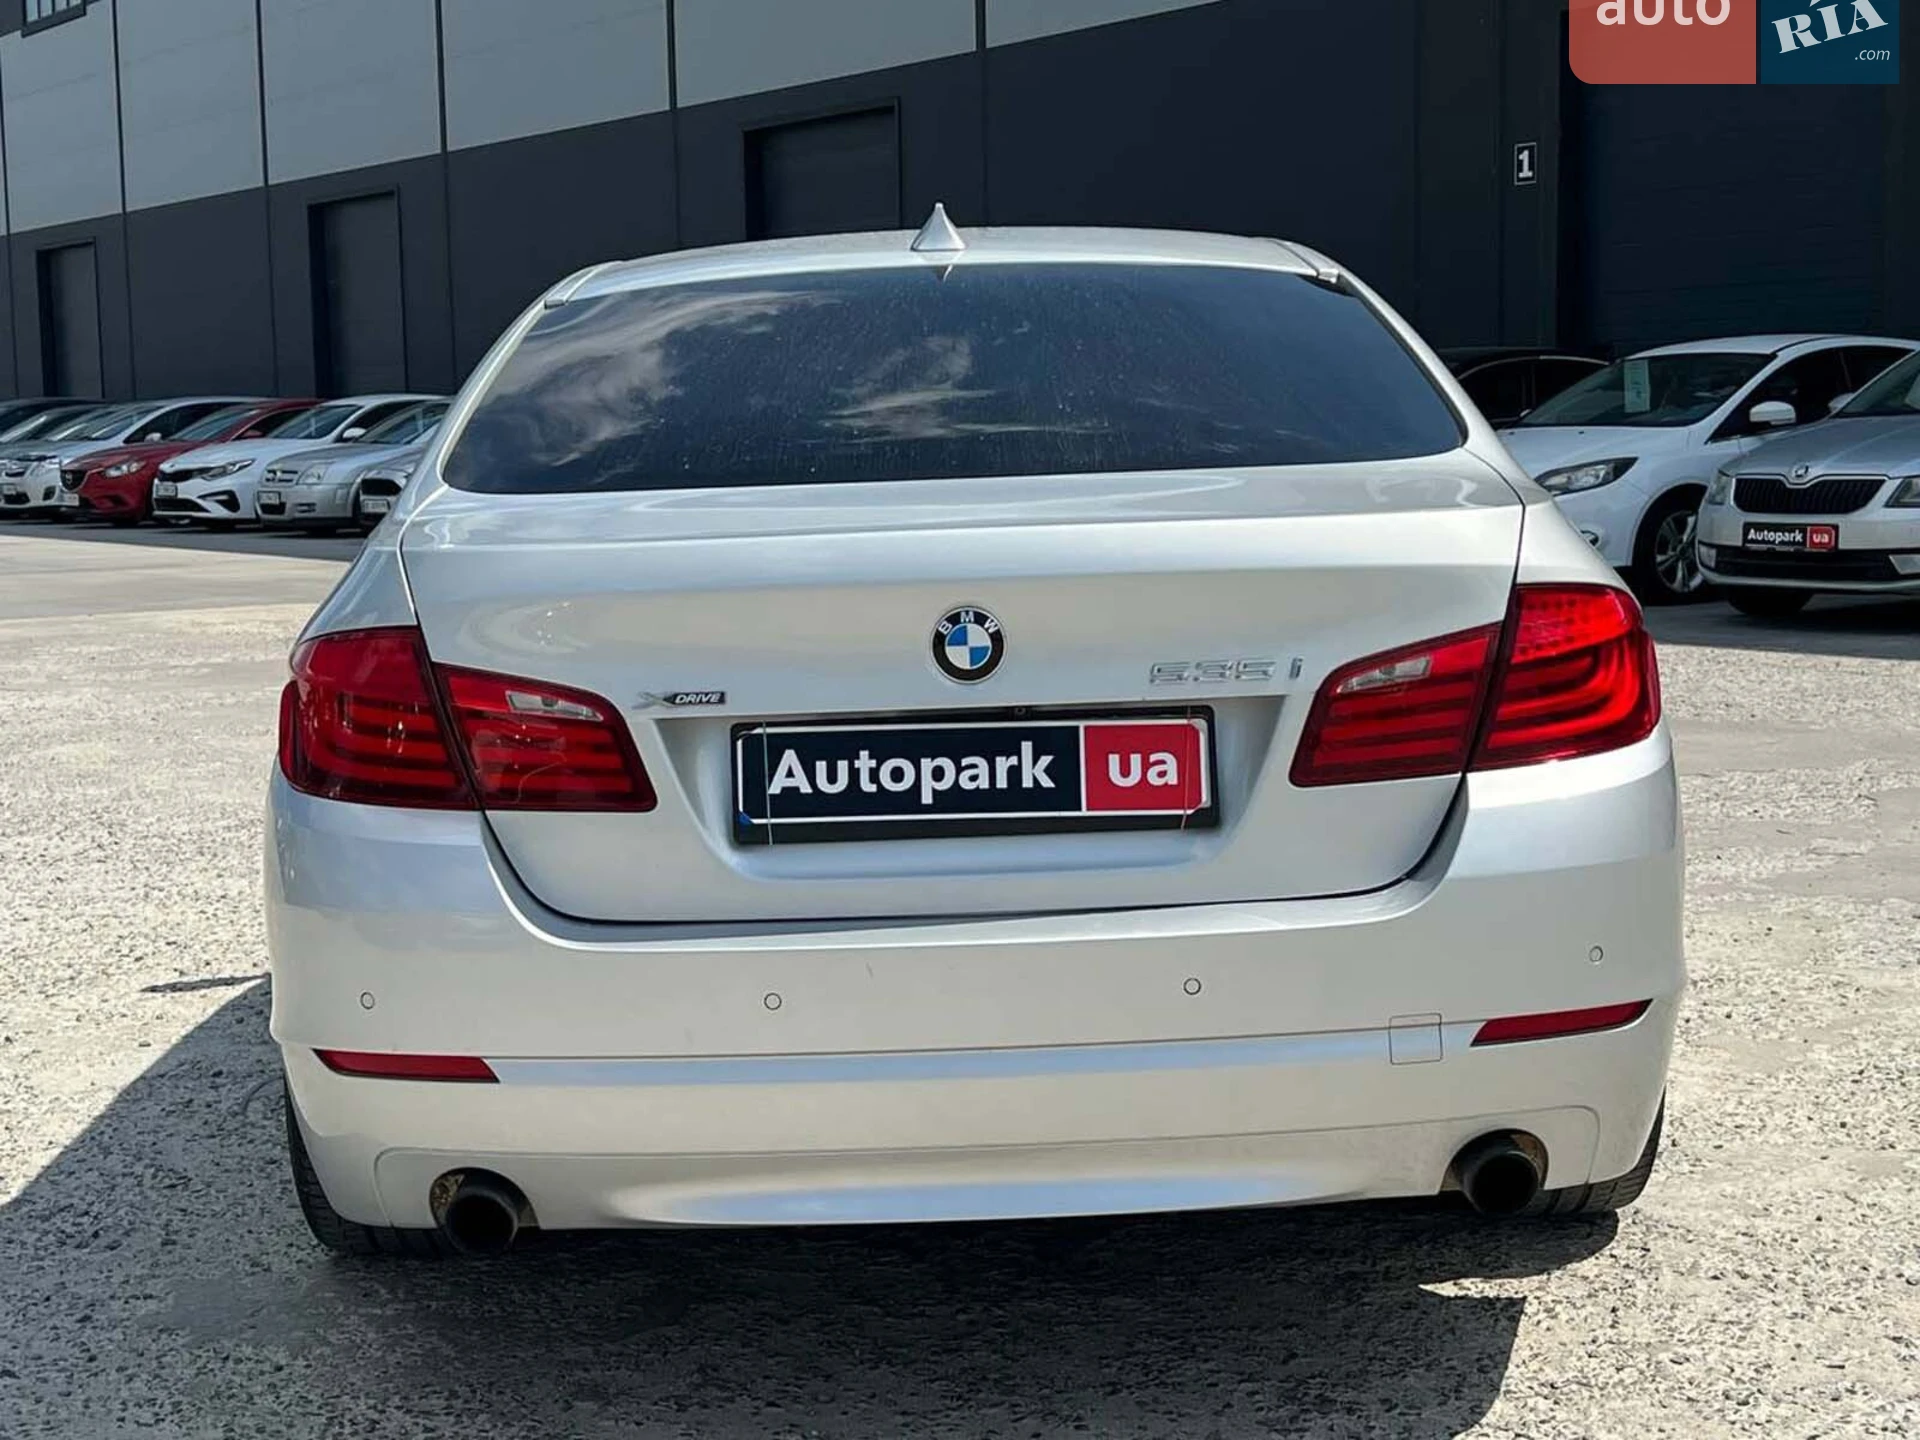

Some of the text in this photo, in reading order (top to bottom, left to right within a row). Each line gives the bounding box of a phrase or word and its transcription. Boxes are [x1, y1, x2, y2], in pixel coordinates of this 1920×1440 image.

[1518, 149, 1533, 178] 1
[1747, 528, 1830, 544] Autopark ua
[938, 610, 1000, 635] BMW
[767, 740, 1179, 805] Autopark ua
